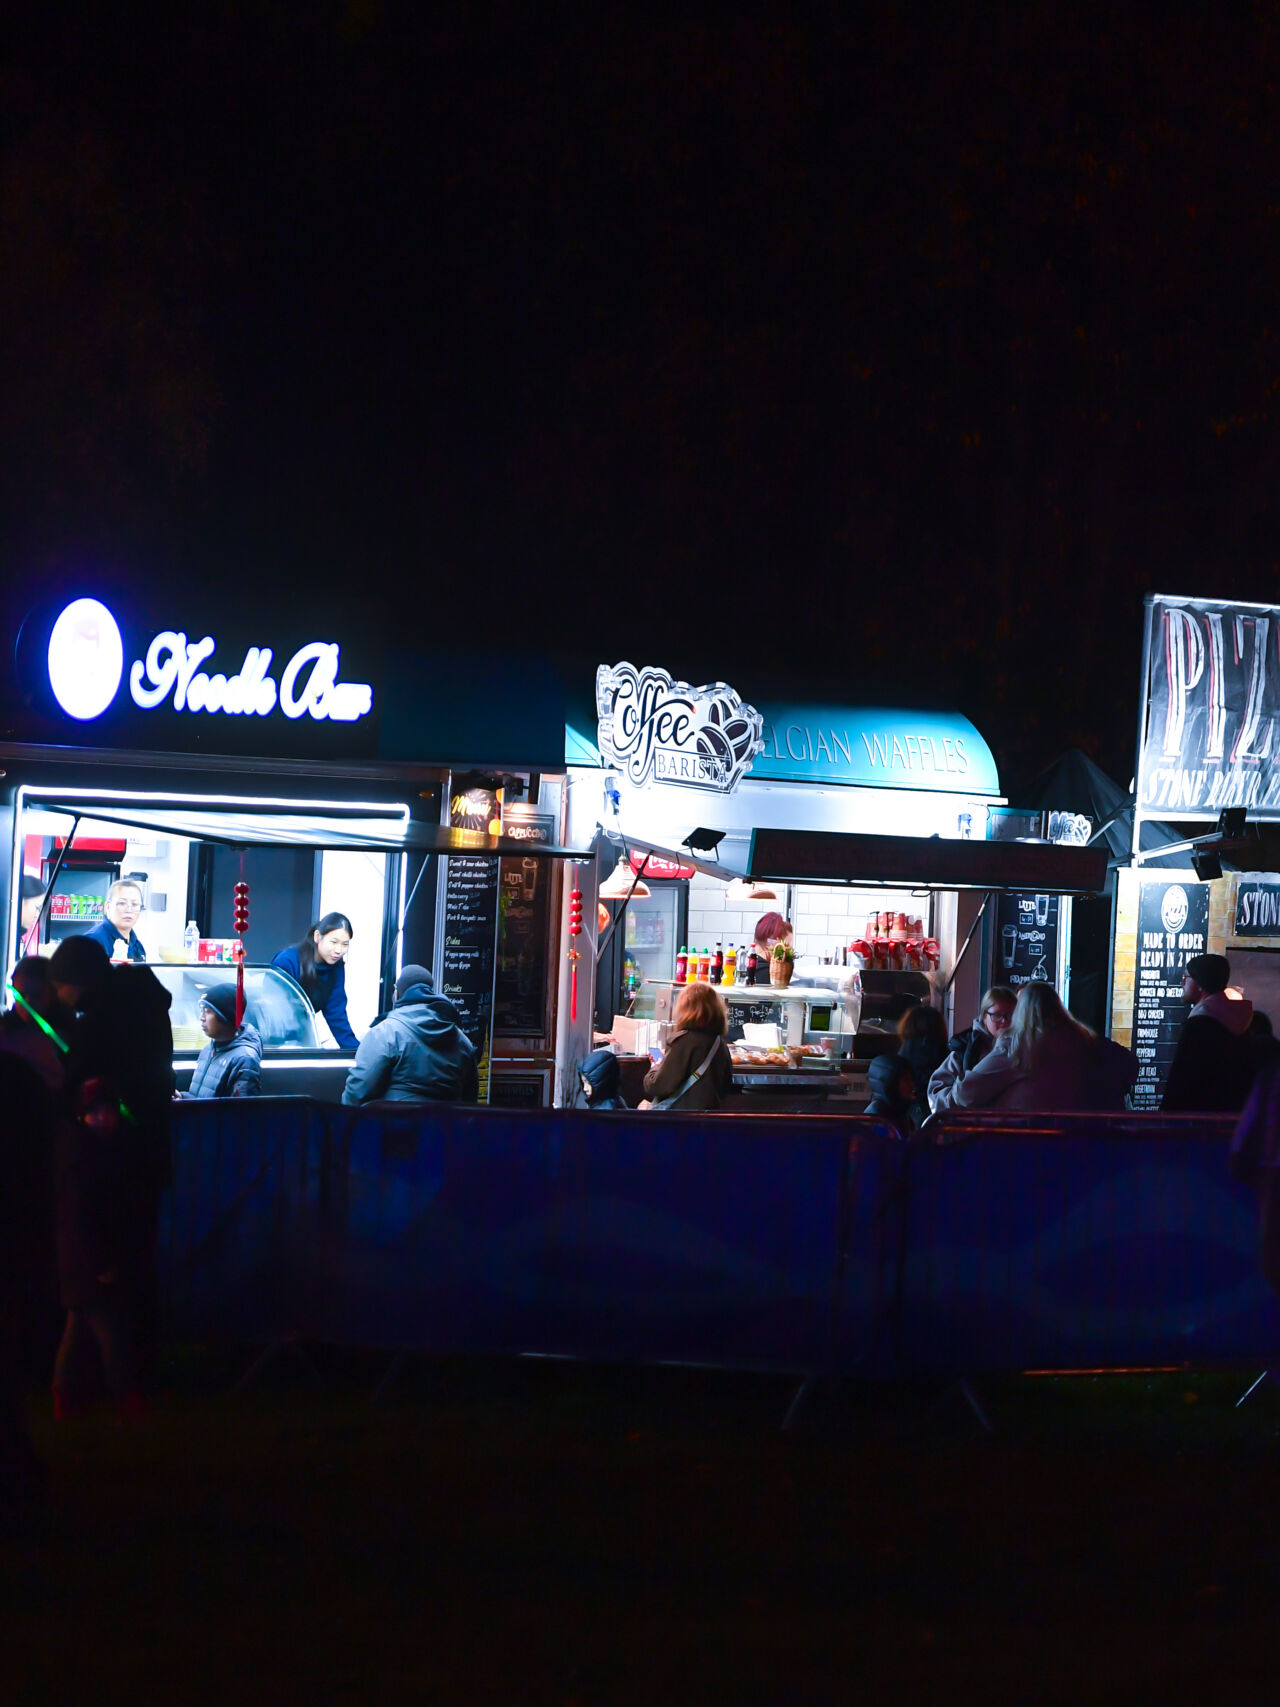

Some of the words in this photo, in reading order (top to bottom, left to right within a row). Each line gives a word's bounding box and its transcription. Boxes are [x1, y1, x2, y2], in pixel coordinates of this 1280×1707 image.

[130, 632, 277, 715] Noodle
[280, 642, 373, 721] Bar
[610, 678, 697, 776] Coffee
[657, 754, 728, 782] BARISTA
[761, 724, 852, 764] ELGIAN
[861, 731, 969, 774] WAFFLES
[1142, 768, 1208, 806] STONE
[1140, 951, 1165, 967] READY
[1167, 951, 1175, 967] IN
[1178, 952, 1183, 967] 2
[1143, 932, 1164, 949] MADE
[1166, 932, 1175, 949] TO
[1178, 933, 1204, 949] ORDER
